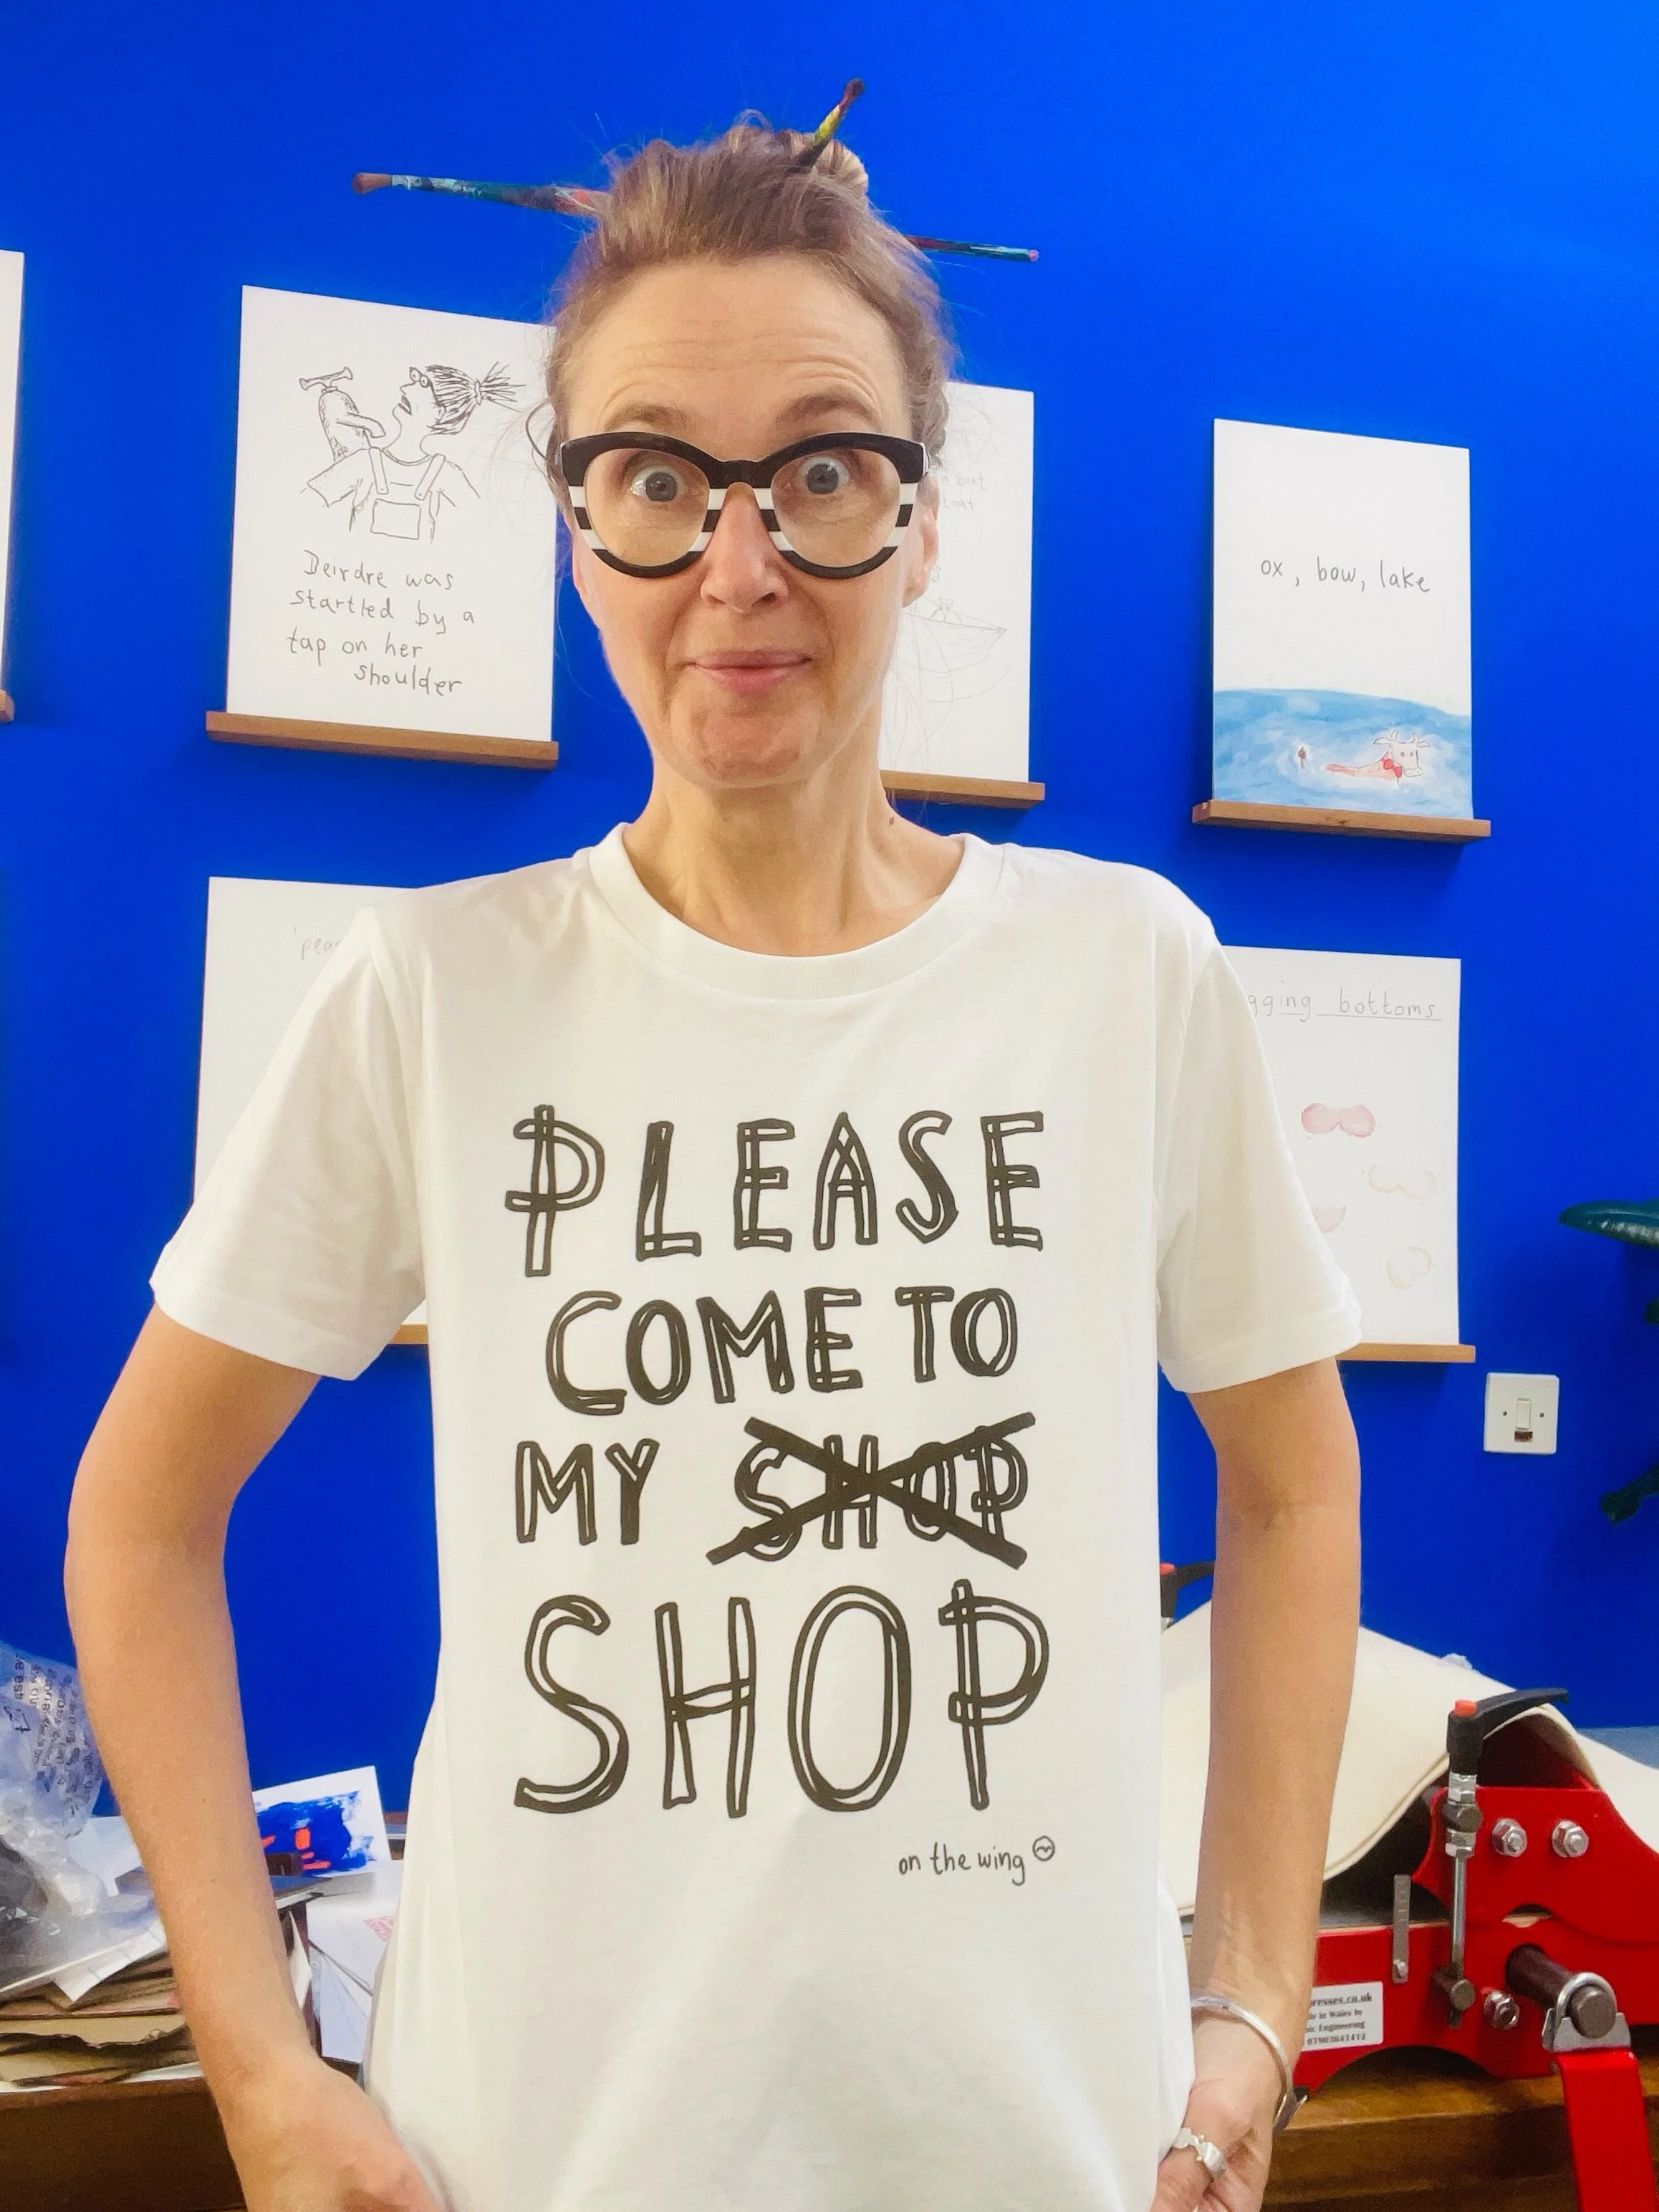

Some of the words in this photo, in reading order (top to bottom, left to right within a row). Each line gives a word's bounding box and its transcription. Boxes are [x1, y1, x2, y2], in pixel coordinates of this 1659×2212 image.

[304, 549, 388, 589] Deirdre
[405, 573, 453, 590] was
[1317, 556, 1365, 592] bow,
[1380, 559, 1430, 593] lake
[289, 589, 395, 619] startled
[415, 600, 446, 635] by
[463, 611, 475, 624] a
[286, 627, 326, 666] tap
[342, 640, 367, 655] on
[385, 631, 423, 658] her
[353, 663, 463, 697] shoulder
[1339, 986, 1436, 1019] bottoms
[505, 1105, 1044, 1277] PLEASE
[545, 1287, 863, 1416] COME
[895, 1287, 1018, 1383] TO
[515, 1438, 660, 1546] MY
[734, 1425, 1029, 1562] SHOP
[514, 1578, 1049, 1819] SHOP
[898, 1855, 921, 1875] on
[930, 1842, 971, 1875] the
[978, 1852, 1026, 1886] wing
